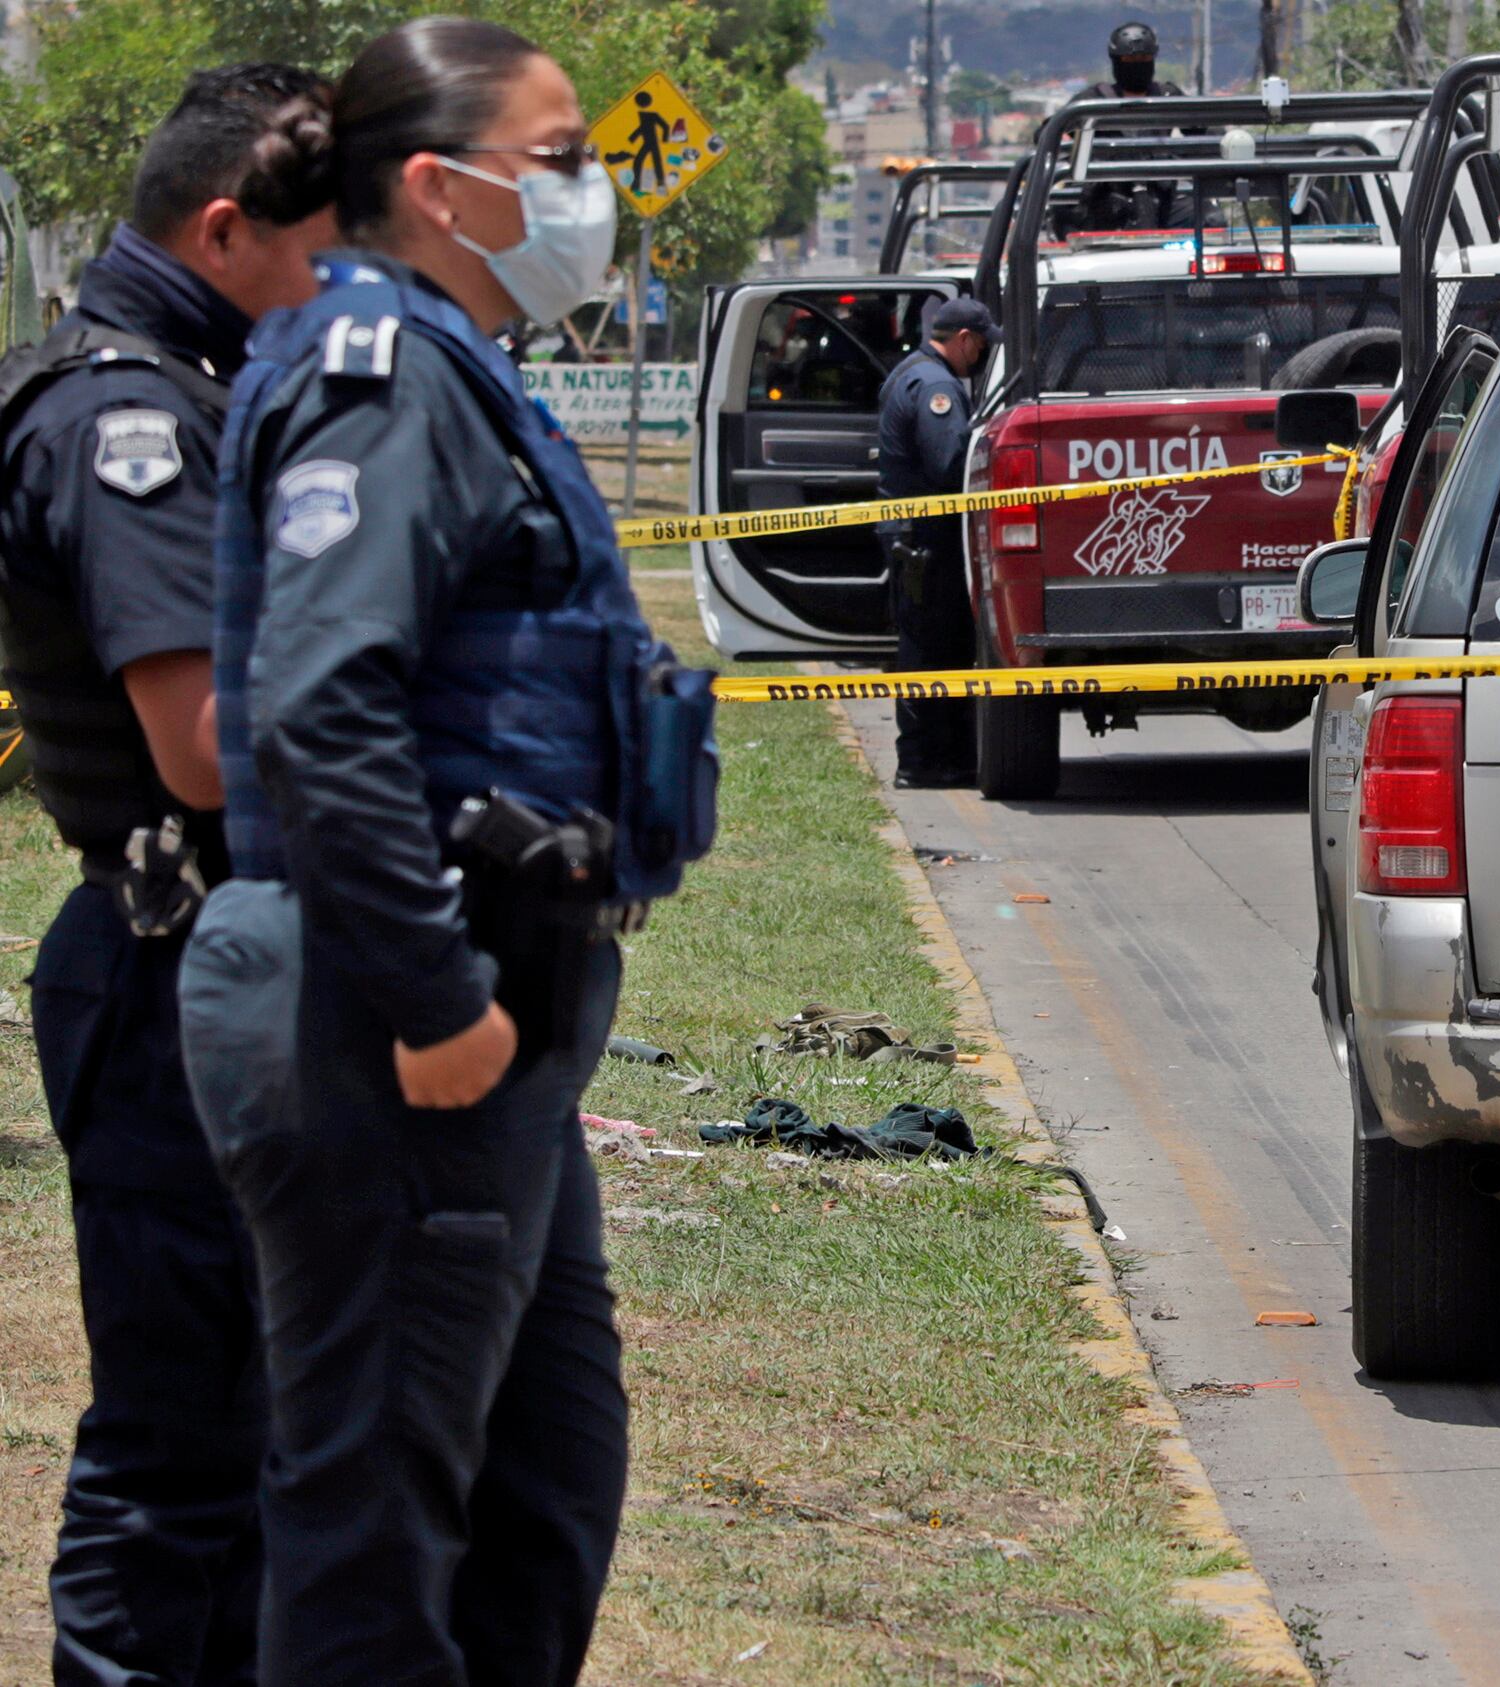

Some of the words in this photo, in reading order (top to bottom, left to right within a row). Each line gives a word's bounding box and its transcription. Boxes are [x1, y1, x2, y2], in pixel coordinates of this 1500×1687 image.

[524, 370, 552, 390] DA
[1069, 428, 1229, 481] POLICÍA
[738, 509, 838, 535] PROHIBIDO
[880, 500, 929, 522] PASO
[652, 517, 701, 541] PASO
[1242, 543, 1312, 556] Hacer
[1242, 556, 1306, 569] Hace
